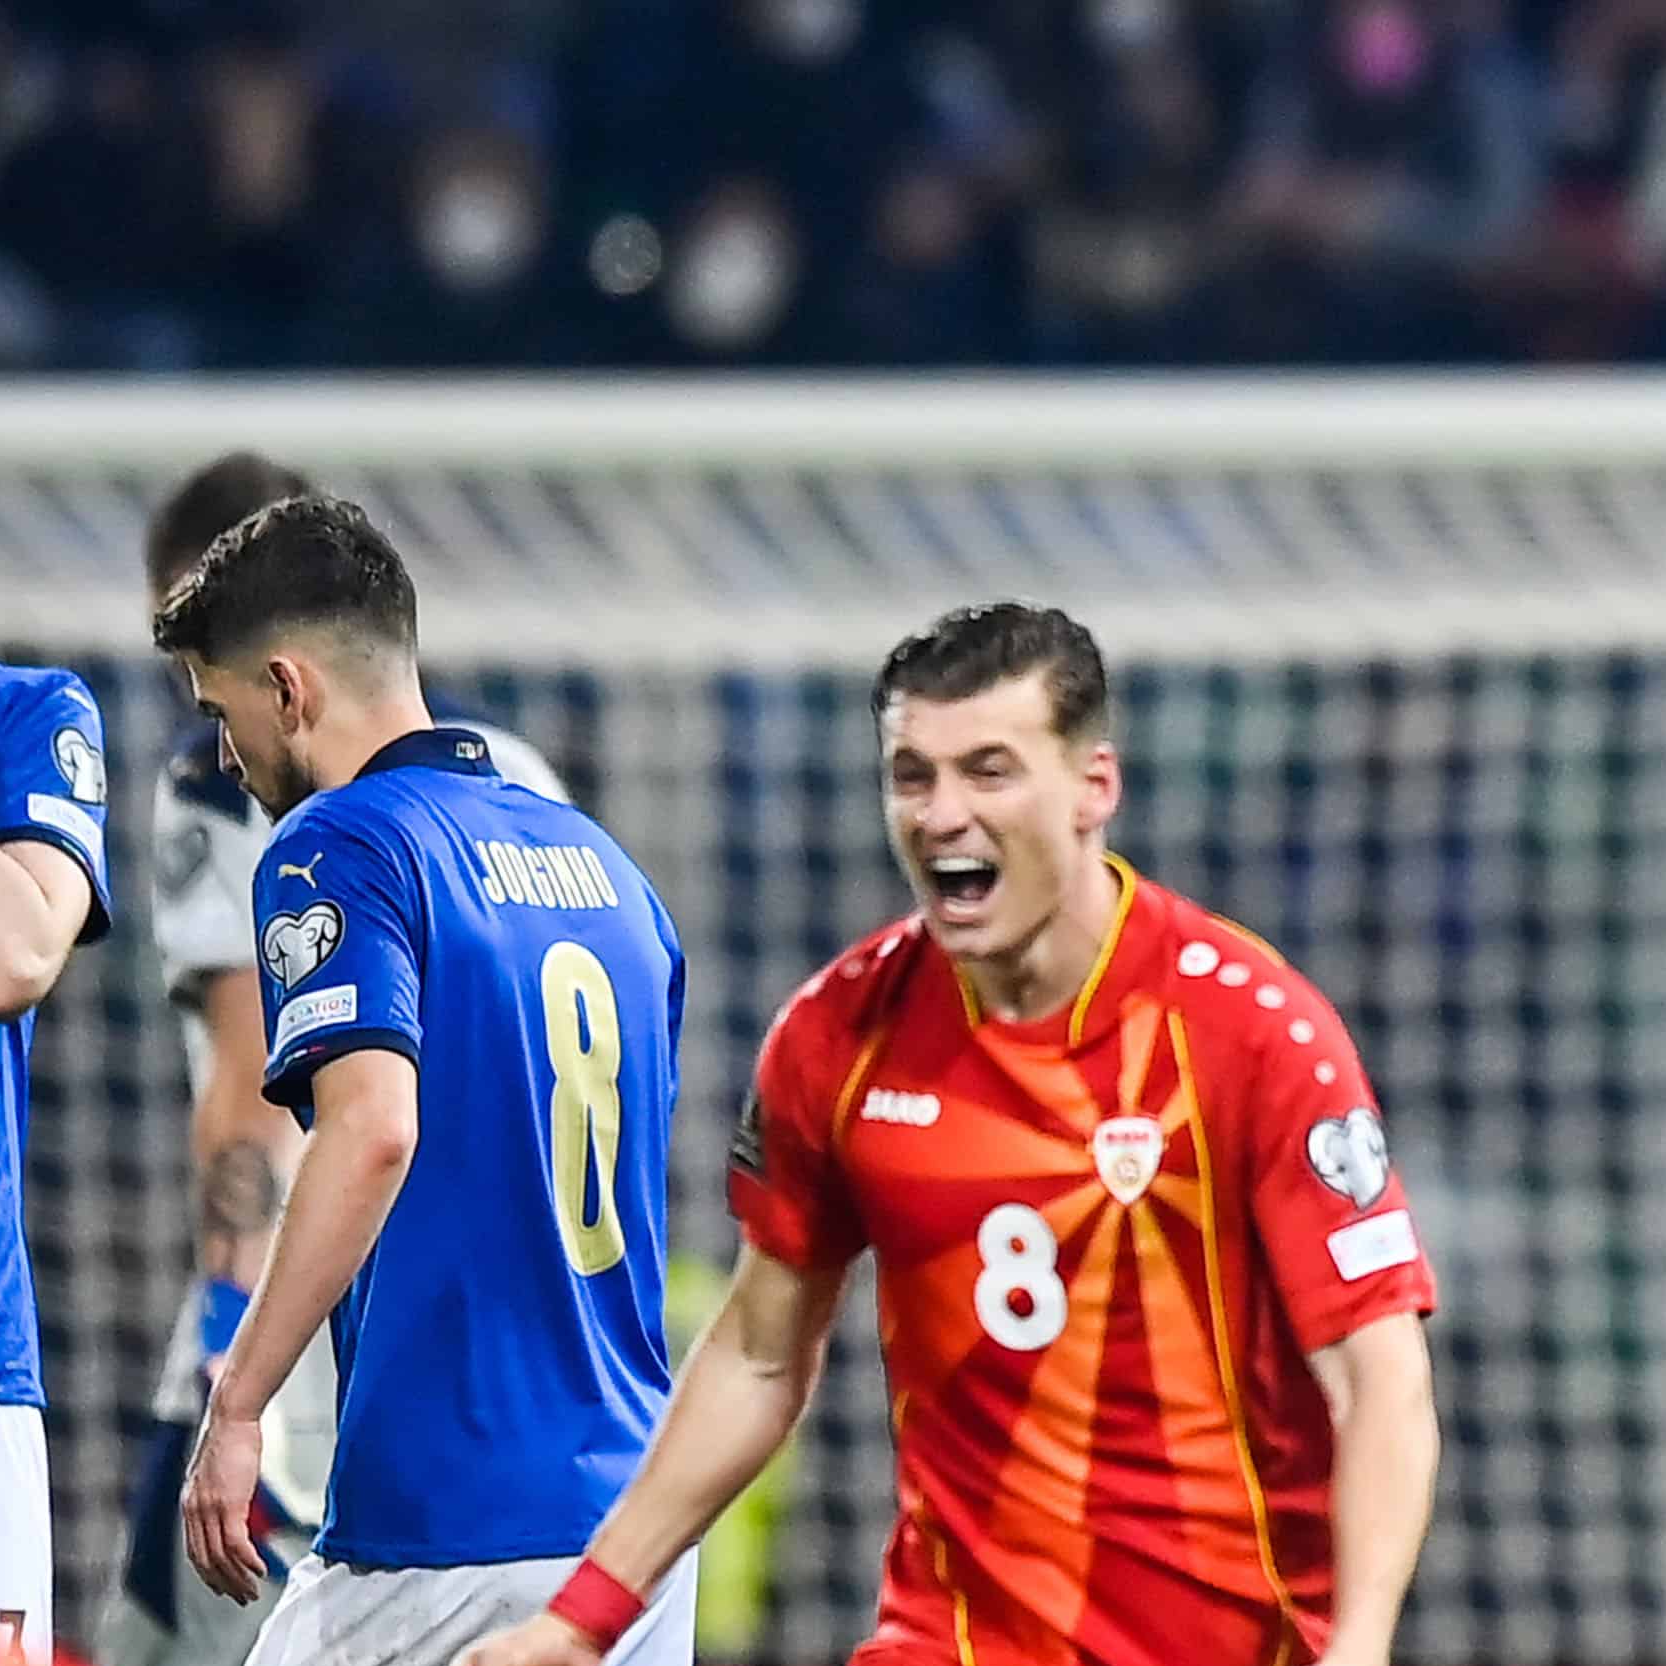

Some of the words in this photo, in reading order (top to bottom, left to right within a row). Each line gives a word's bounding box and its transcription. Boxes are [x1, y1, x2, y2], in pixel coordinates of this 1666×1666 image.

[475, 840, 619, 909] JORGINHO
[540, 942, 624, 1276] 8
[973, 1203, 1067, 1351] 8
